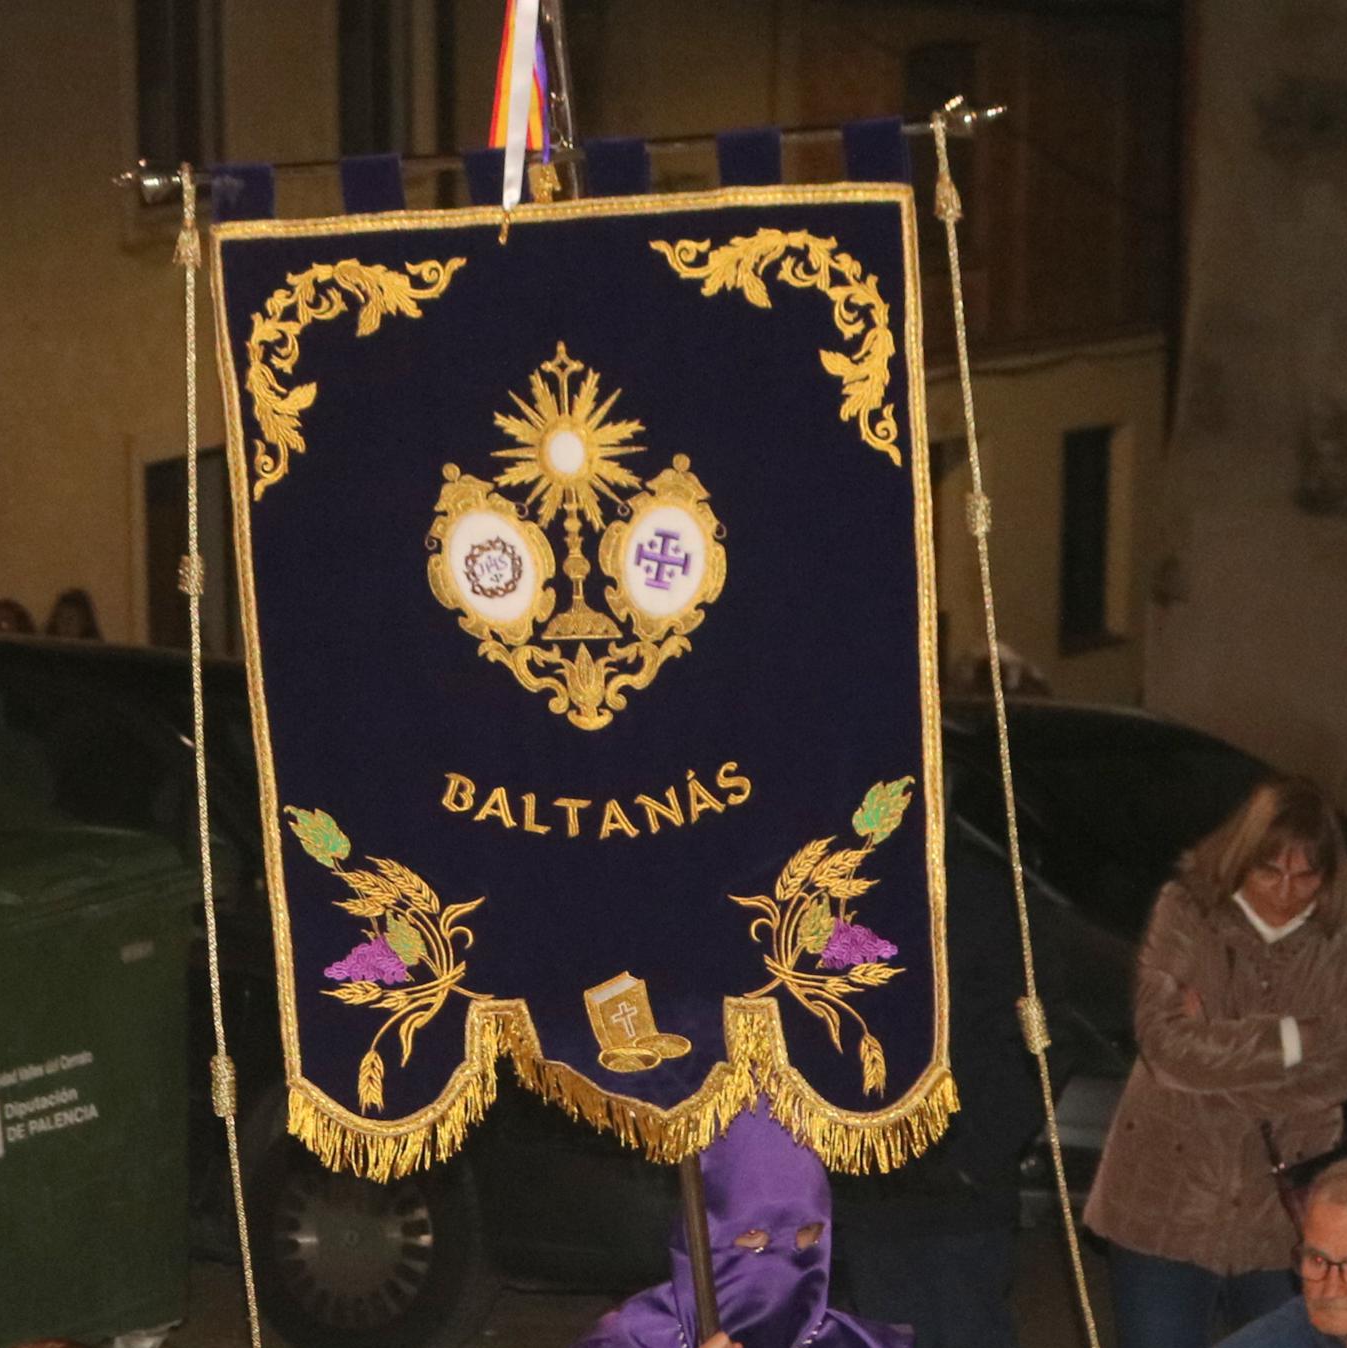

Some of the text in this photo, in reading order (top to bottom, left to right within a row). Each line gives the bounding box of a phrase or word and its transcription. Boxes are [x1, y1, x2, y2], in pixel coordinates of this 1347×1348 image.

[441, 760, 752, 840] BALTANÁS
[4, 1088, 78, 1118] Diputación
[6, 1104, 99, 1143] DE PALENCIA
